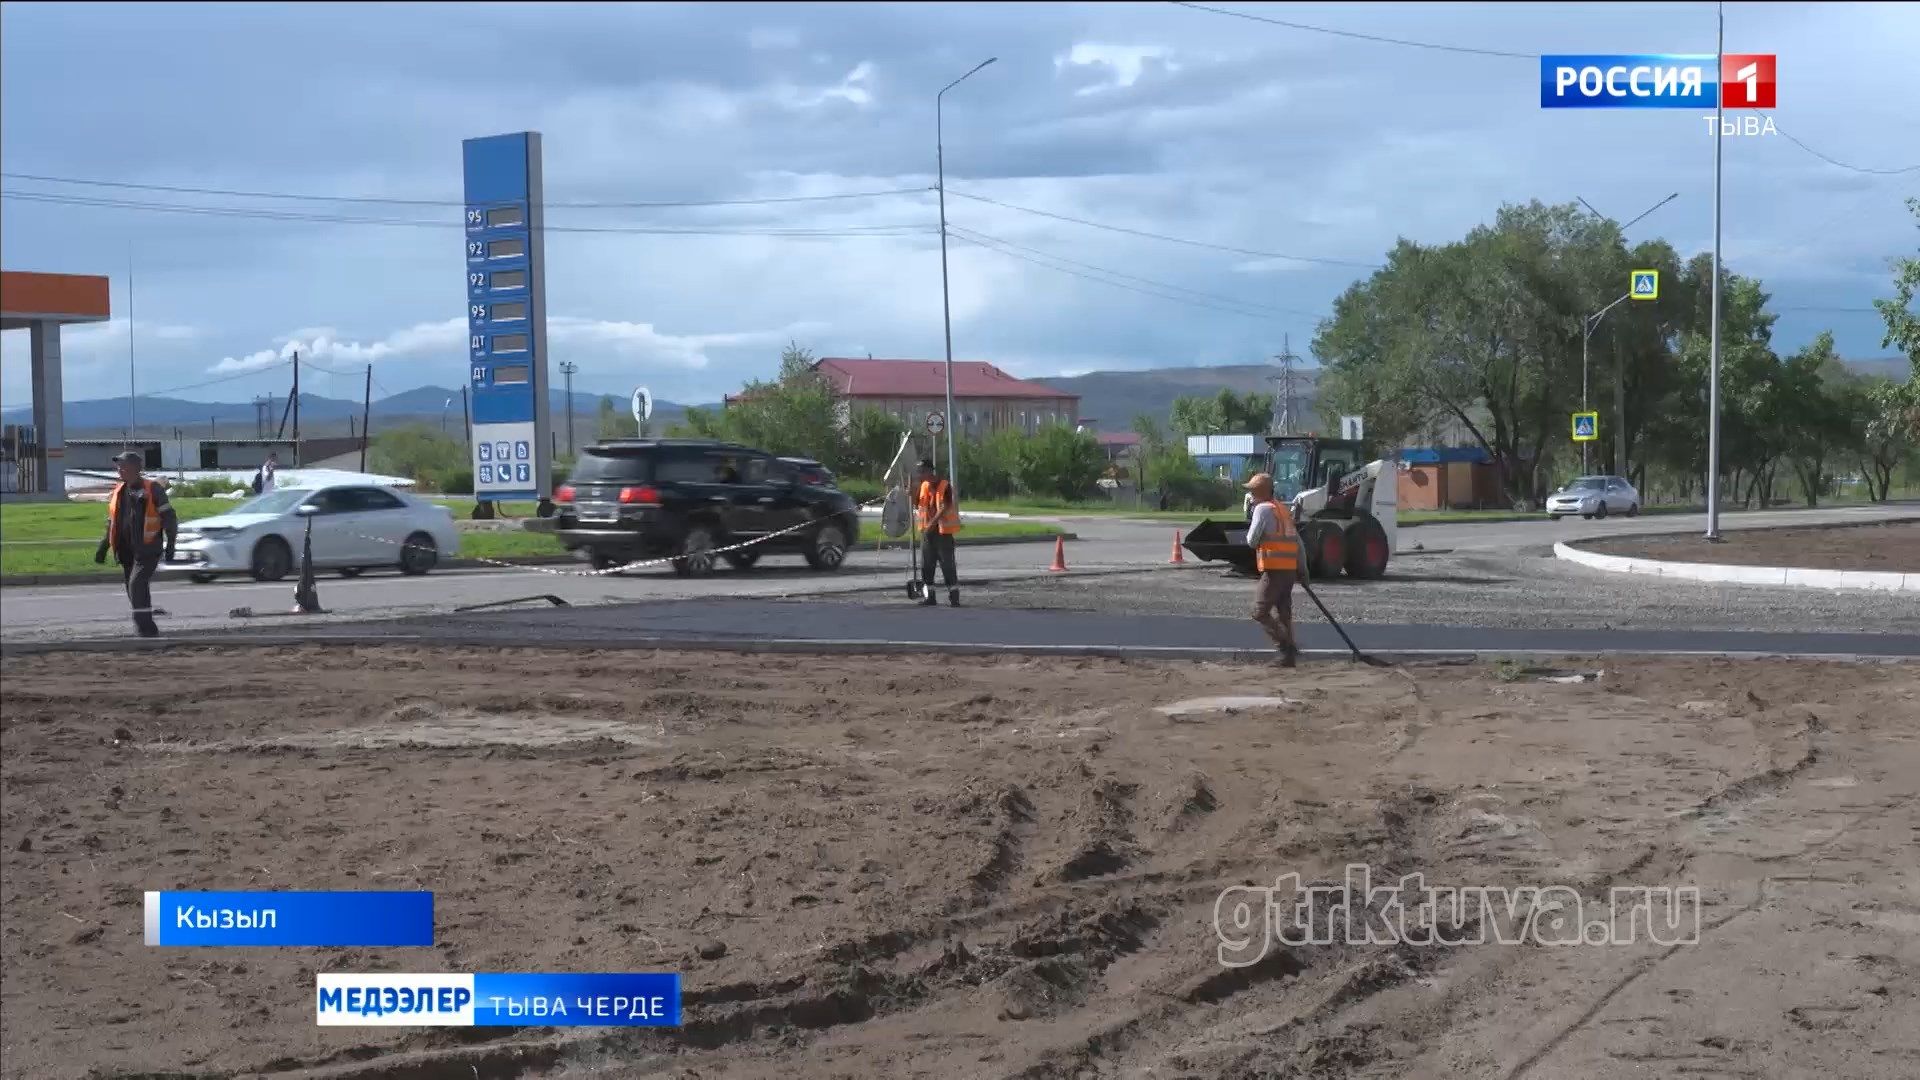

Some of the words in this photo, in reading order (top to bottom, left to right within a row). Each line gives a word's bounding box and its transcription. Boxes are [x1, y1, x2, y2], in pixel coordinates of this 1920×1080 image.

[467, 209, 482, 224] 95
[469, 241, 483, 255] 92
[470, 272, 484, 286] 92
[471, 304, 486, 318] 95
[471, 335, 486, 349] ДТ
[472, 367, 487, 381] ДТ
